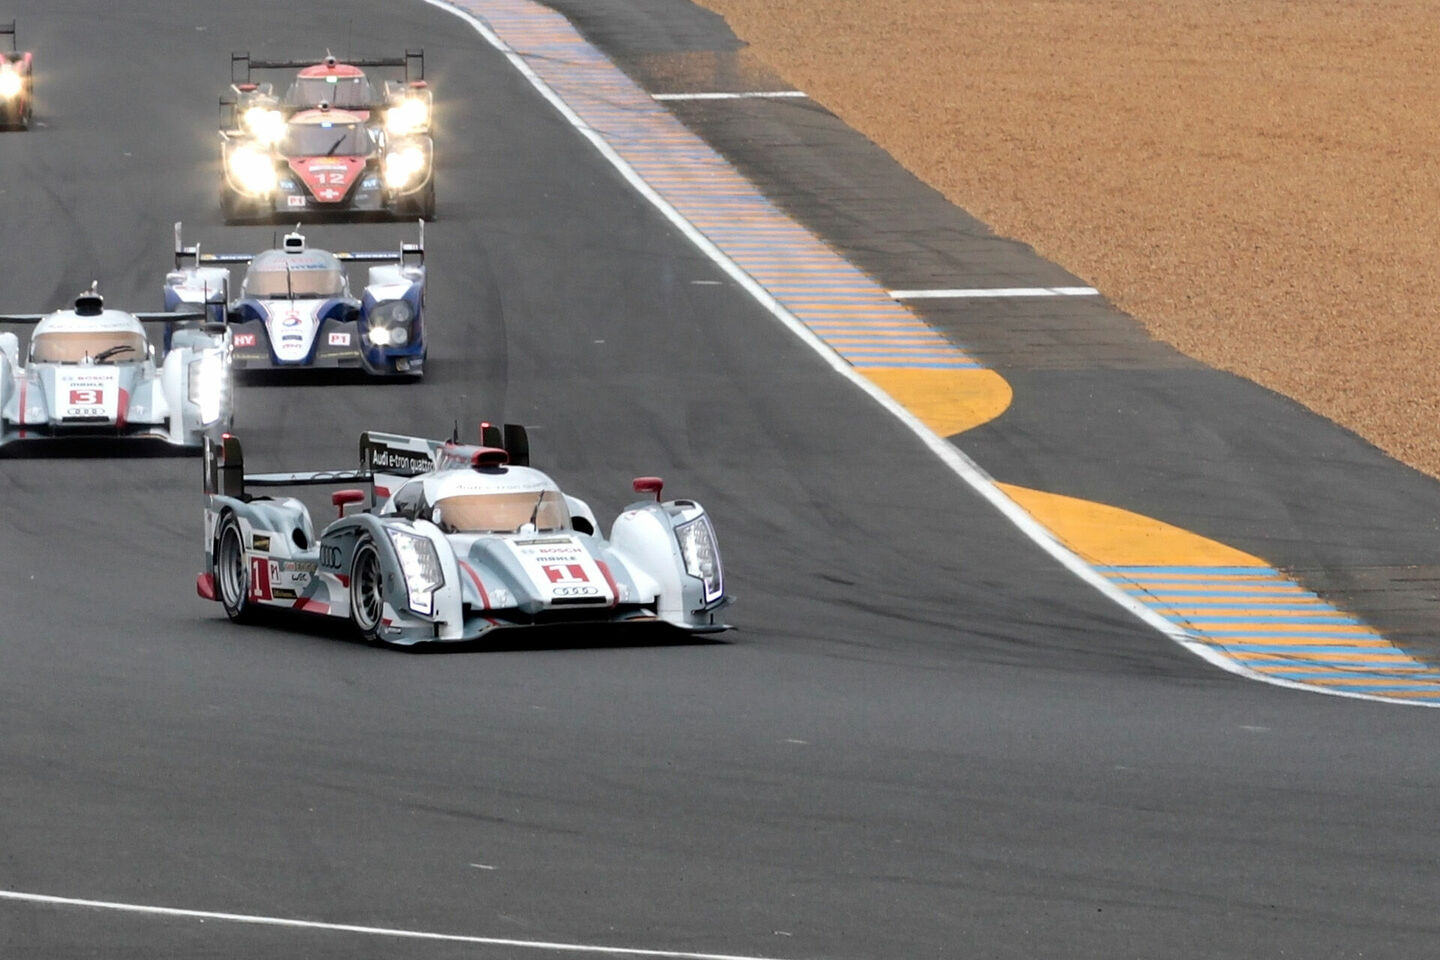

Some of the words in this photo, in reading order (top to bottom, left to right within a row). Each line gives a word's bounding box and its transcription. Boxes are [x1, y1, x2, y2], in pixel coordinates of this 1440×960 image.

[314, 173, 346, 185] 12
[234, 335, 254, 346] HY
[75, 390, 97, 404] 3
[373, 449, 388, 466] Audi
[389, 453, 409, 470] e-tron
[252, 559, 264, 596] 1
[548, 564, 584, 582] 1
